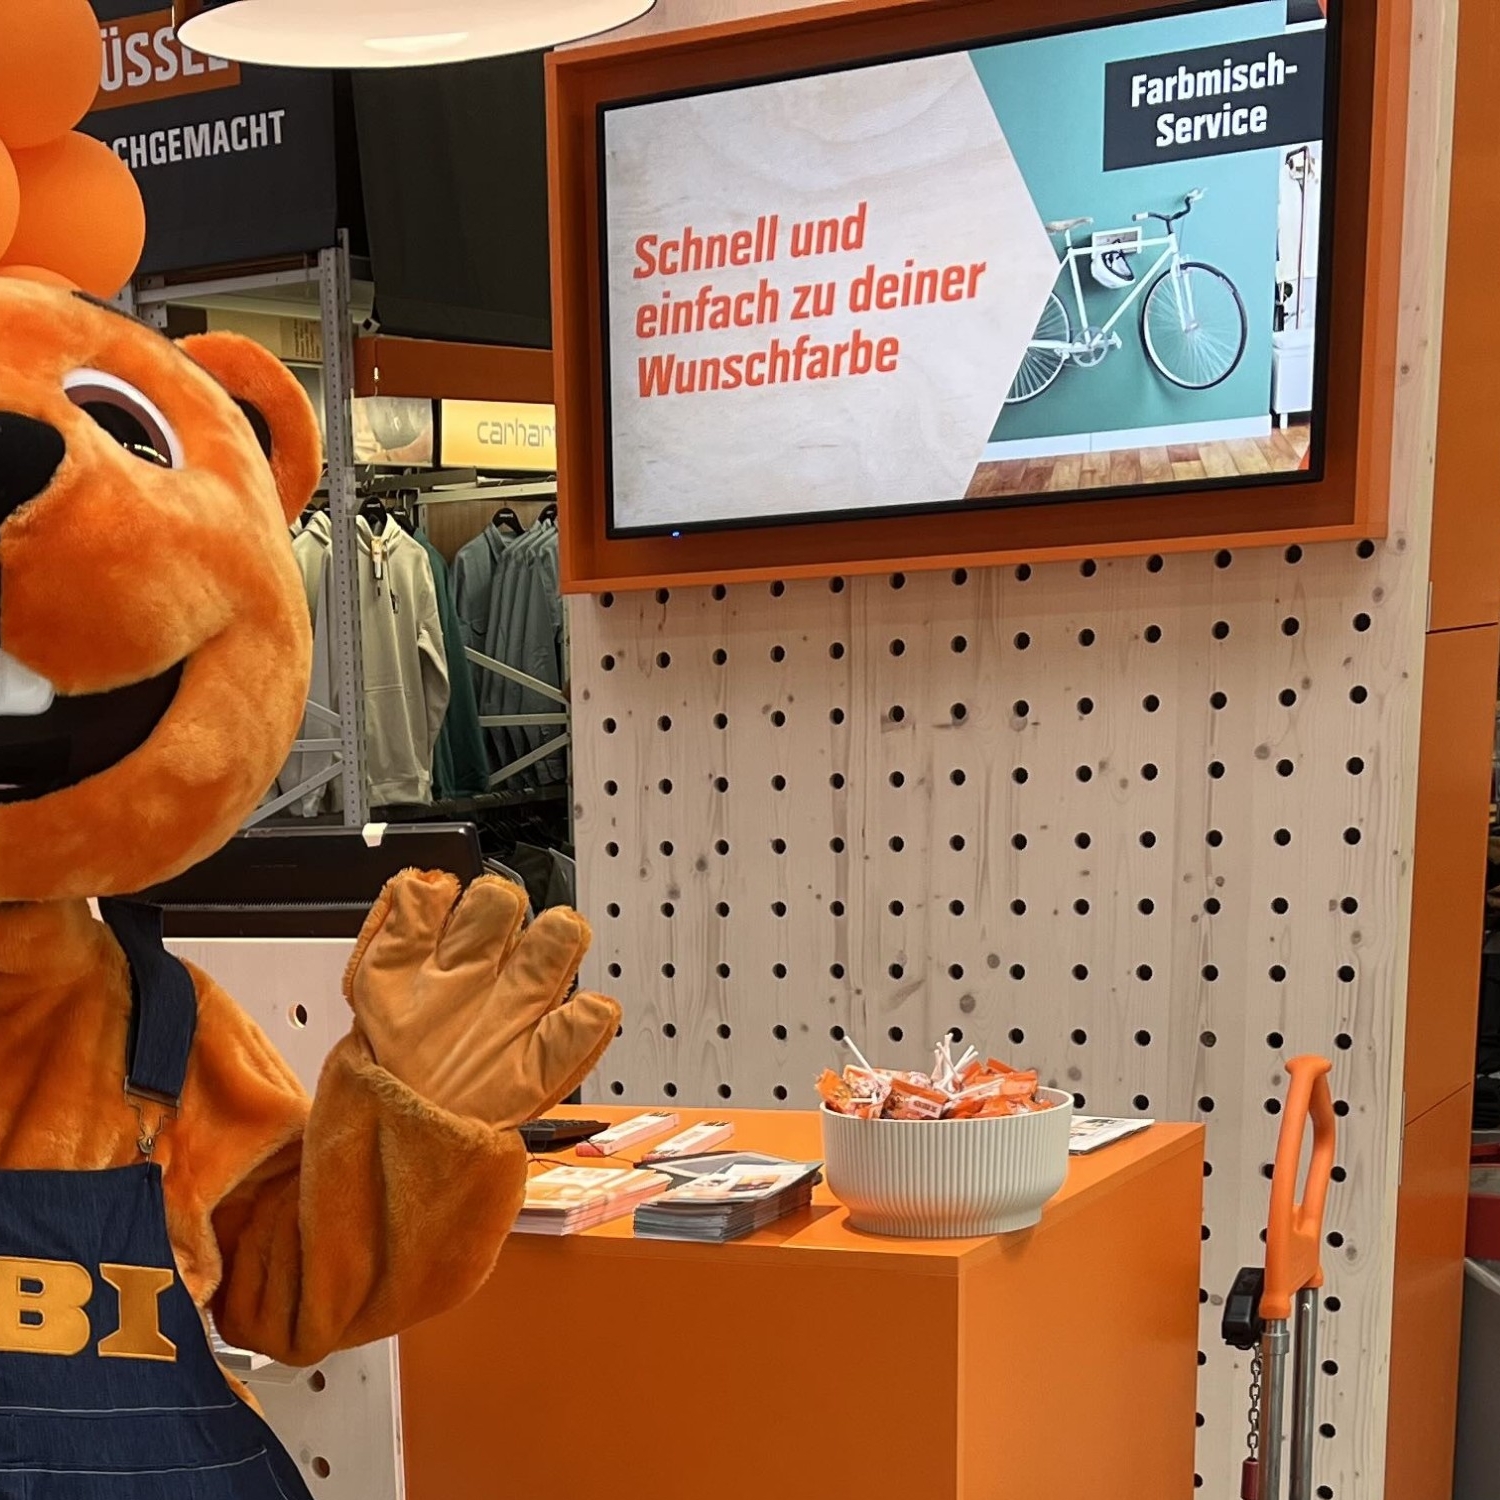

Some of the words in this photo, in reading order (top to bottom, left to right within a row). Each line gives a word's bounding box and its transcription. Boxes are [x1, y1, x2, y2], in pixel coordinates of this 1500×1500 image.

[100, 26, 229, 92] ÜSS
[1131, 51, 1298, 107] Farbmisch-
[102, 109, 285, 169] CHGEMACHT
[1156, 102, 1268, 147] Service
[633, 214, 779, 279] Schnell
[790, 201, 867, 258] und
[636, 278, 780, 339] einfach
[790, 281, 836, 320] zu
[849, 259, 987, 313] deiner
[638, 328, 899, 398] Wunschfarbe
[477, 418, 556, 447] carhar
